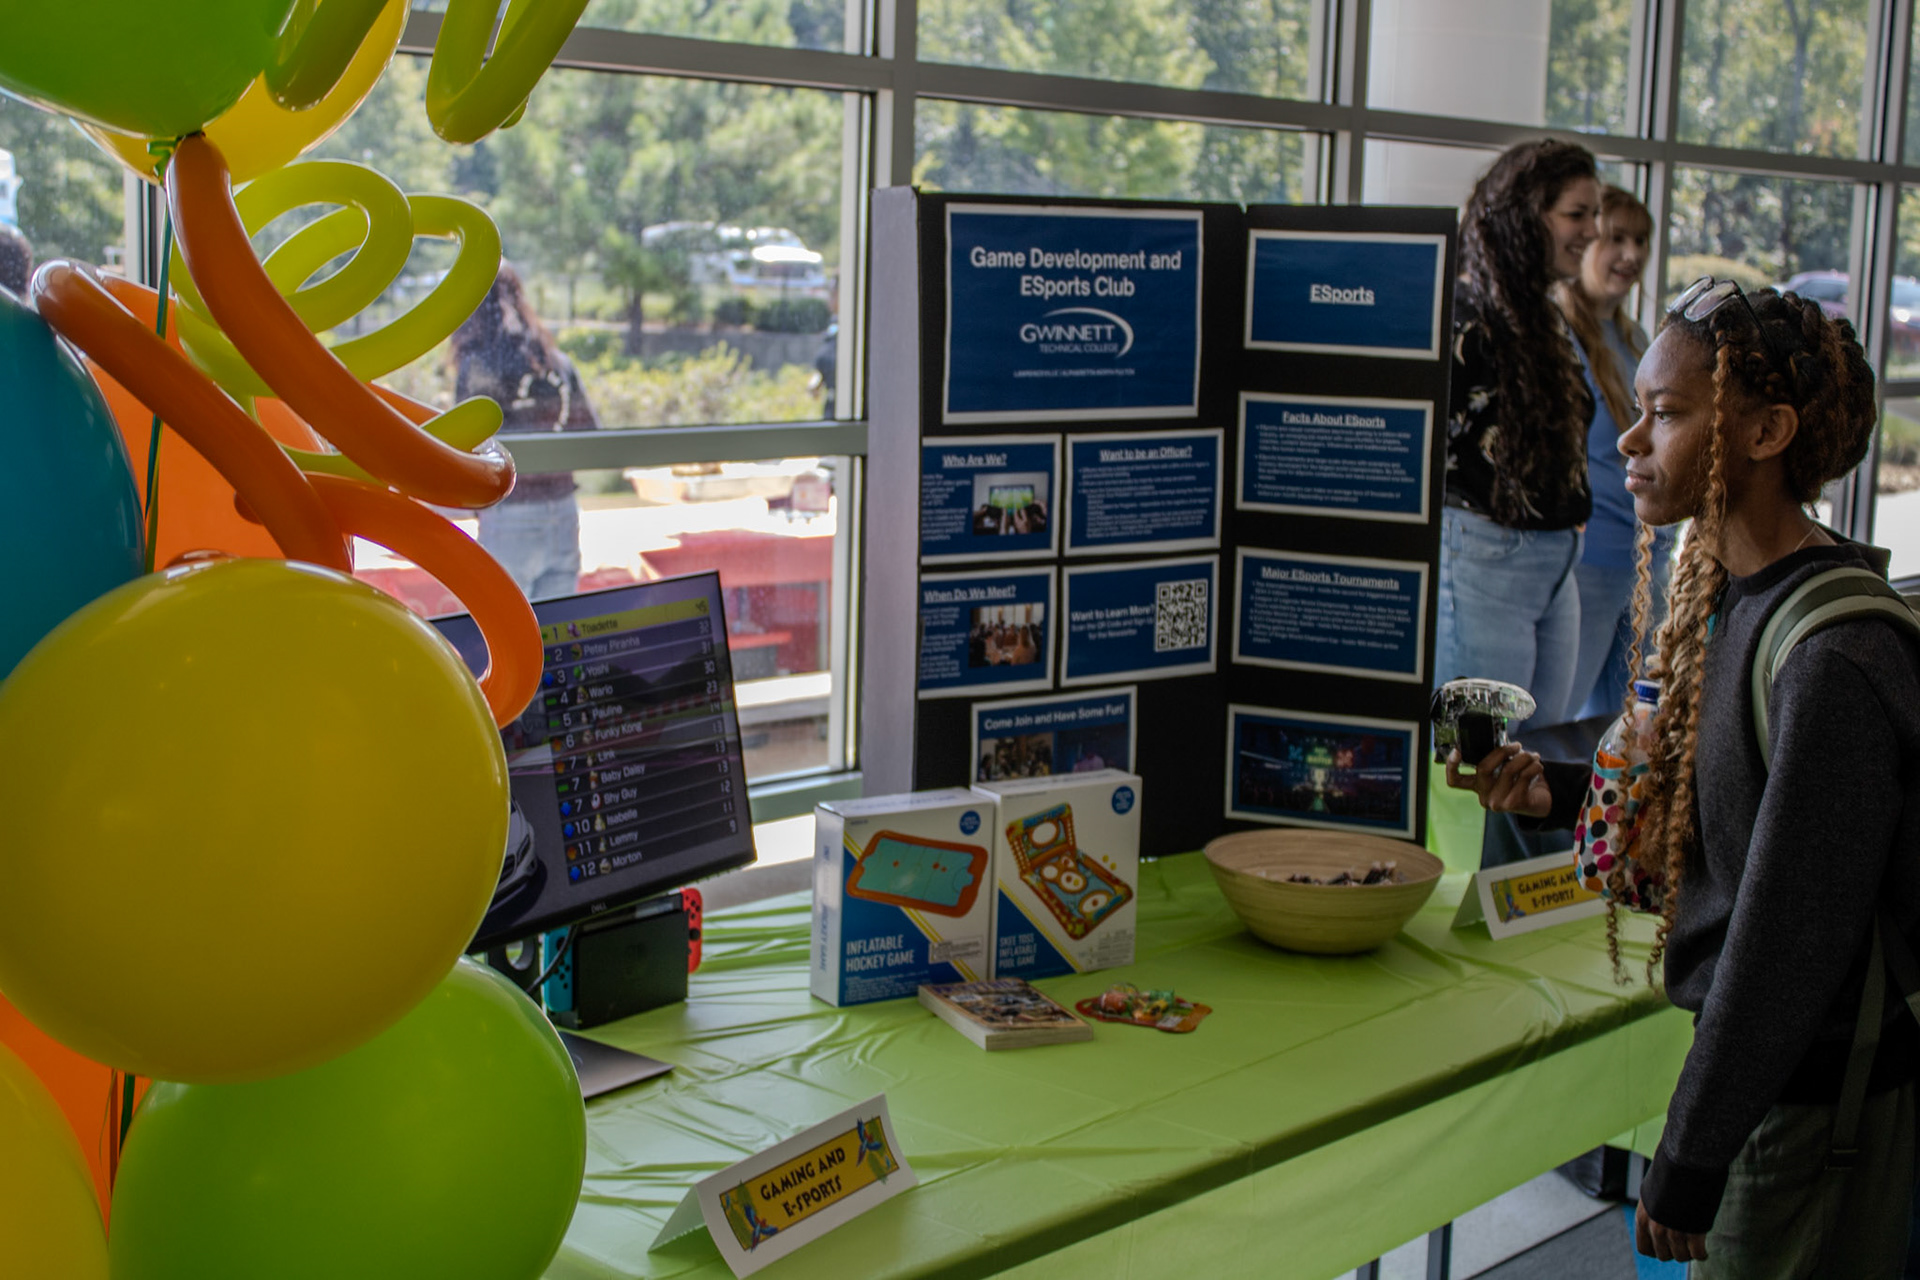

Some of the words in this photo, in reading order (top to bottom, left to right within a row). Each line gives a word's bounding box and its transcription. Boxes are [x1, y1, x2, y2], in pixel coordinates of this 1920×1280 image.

[970, 246, 1026, 268] Game
[1030, 248, 1146, 273] Development
[1149, 250, 1182, 270] and
[1020, 275, 1091, 300] ESports
[1094, 276, 1135, 297] Club
[1310, 283, 1375, 305] ESports
[1020, 323, 1116, 343] GWINNETT
[1039, 343, 1082, 354] TECHNICAL
[1083, 343, 1119, 353] COLLEGE
[1282, 410, 1311, 424] Facts
[1312, 413, 1344, 426] About
[1345, 414, 1386, 428] ESports
[942, 454, 965, 468] Who
[966, 454, 984, 467] Are
[984, 453, 1008, 467] We?
[1099, 449, 1124, 462] Want
[1124, 449, 1135, 461] to
[1135, 447, 1148, 460] be
[1148, 449, 1160, 460] an
[1160, 445, 1193, 459] Officer?
[1261, 566, 1290, 580] Major
[1291, 569, 1331, 584] ESports
[1333, 573, 1400, 590] Tournaments
[924, 590, 953, 604] When
[954, 588, 968, 602] Do
[968, 587, 986, 601] We
[987, 585, 1017, 600] Meet?
[1071, 609, 1093, 622] Want
[1095, 609, 1105, 619] to
[1106, 606, 1128, 618] Learn
[1129, 603, 1155, 615] More?
[552, 626, 559, 639] 1
[581, 617, 618, 634] Toadette
[555, 648, 563, 662] 2
[583, 641, 608, 656] Petey
[608, 636, 640, 650] Piranha
[557, 669, 566, 684] 3
[586, 662, 609, 676] Yoshi
[560, 691, 569, 704] 4
[589, 685, 613, 698] Wario
[563, 713, 571, 727] 5
[592, 705, 623, 719] Pauline
[706, 680, 718, 694] 23
[984, 718, 1013, 731] Come
[1014, 715, 1033, 727] Join
[1034, 713, 1051, 725] and
[1053, 710, 1076, 722] Have
[1078, 707, 1105, 720] Some
[1105, 703, 1125, 716] Fun!
[566, 735, 575, 749] 6
[595, 727, 620, 741] Funky
[621, 721, 643, 735] Kong
[569, 756, 577, 769] 7
[597, 750, 616, 762] Link
[572, 777, 580, 791] 7
[601, 770, 622, 784] Baby
[623, 764, 646, 778] Daisy
[575, 799, 583, 813] 7
[603, 792, 619, 805] Shy
[621, 787, 637, 800] Guy
[717, 761, 729, 773] 13
[576, 819, 590, 834] 10
[606, 809, 638, 826] Isabelle
[720, 781, 731, 793] 12
[578, 842, 592, 856] 11
[609, 831, 639, 847] Lemmy
[723, 801, 733, 813] 11
[581, 862, 596, 877] 12
[612, 851, 642, 868] Morton
[729, 819, 736, 833] 9
[1518, 875, 1558, 895] GAMING
[1531, 889, 1575, 909] E-SPORTS
[846, 934, 904, 956] INFLATABLE
[846, 954, 886, 973] HOCKEY
[887, 949, 915, 967] GAME
[760, 1161, 816, 1201] GAMING
[818, 1147, 846, 1174] AND
[782, 1174, 843, 1218] E-SPORTS
